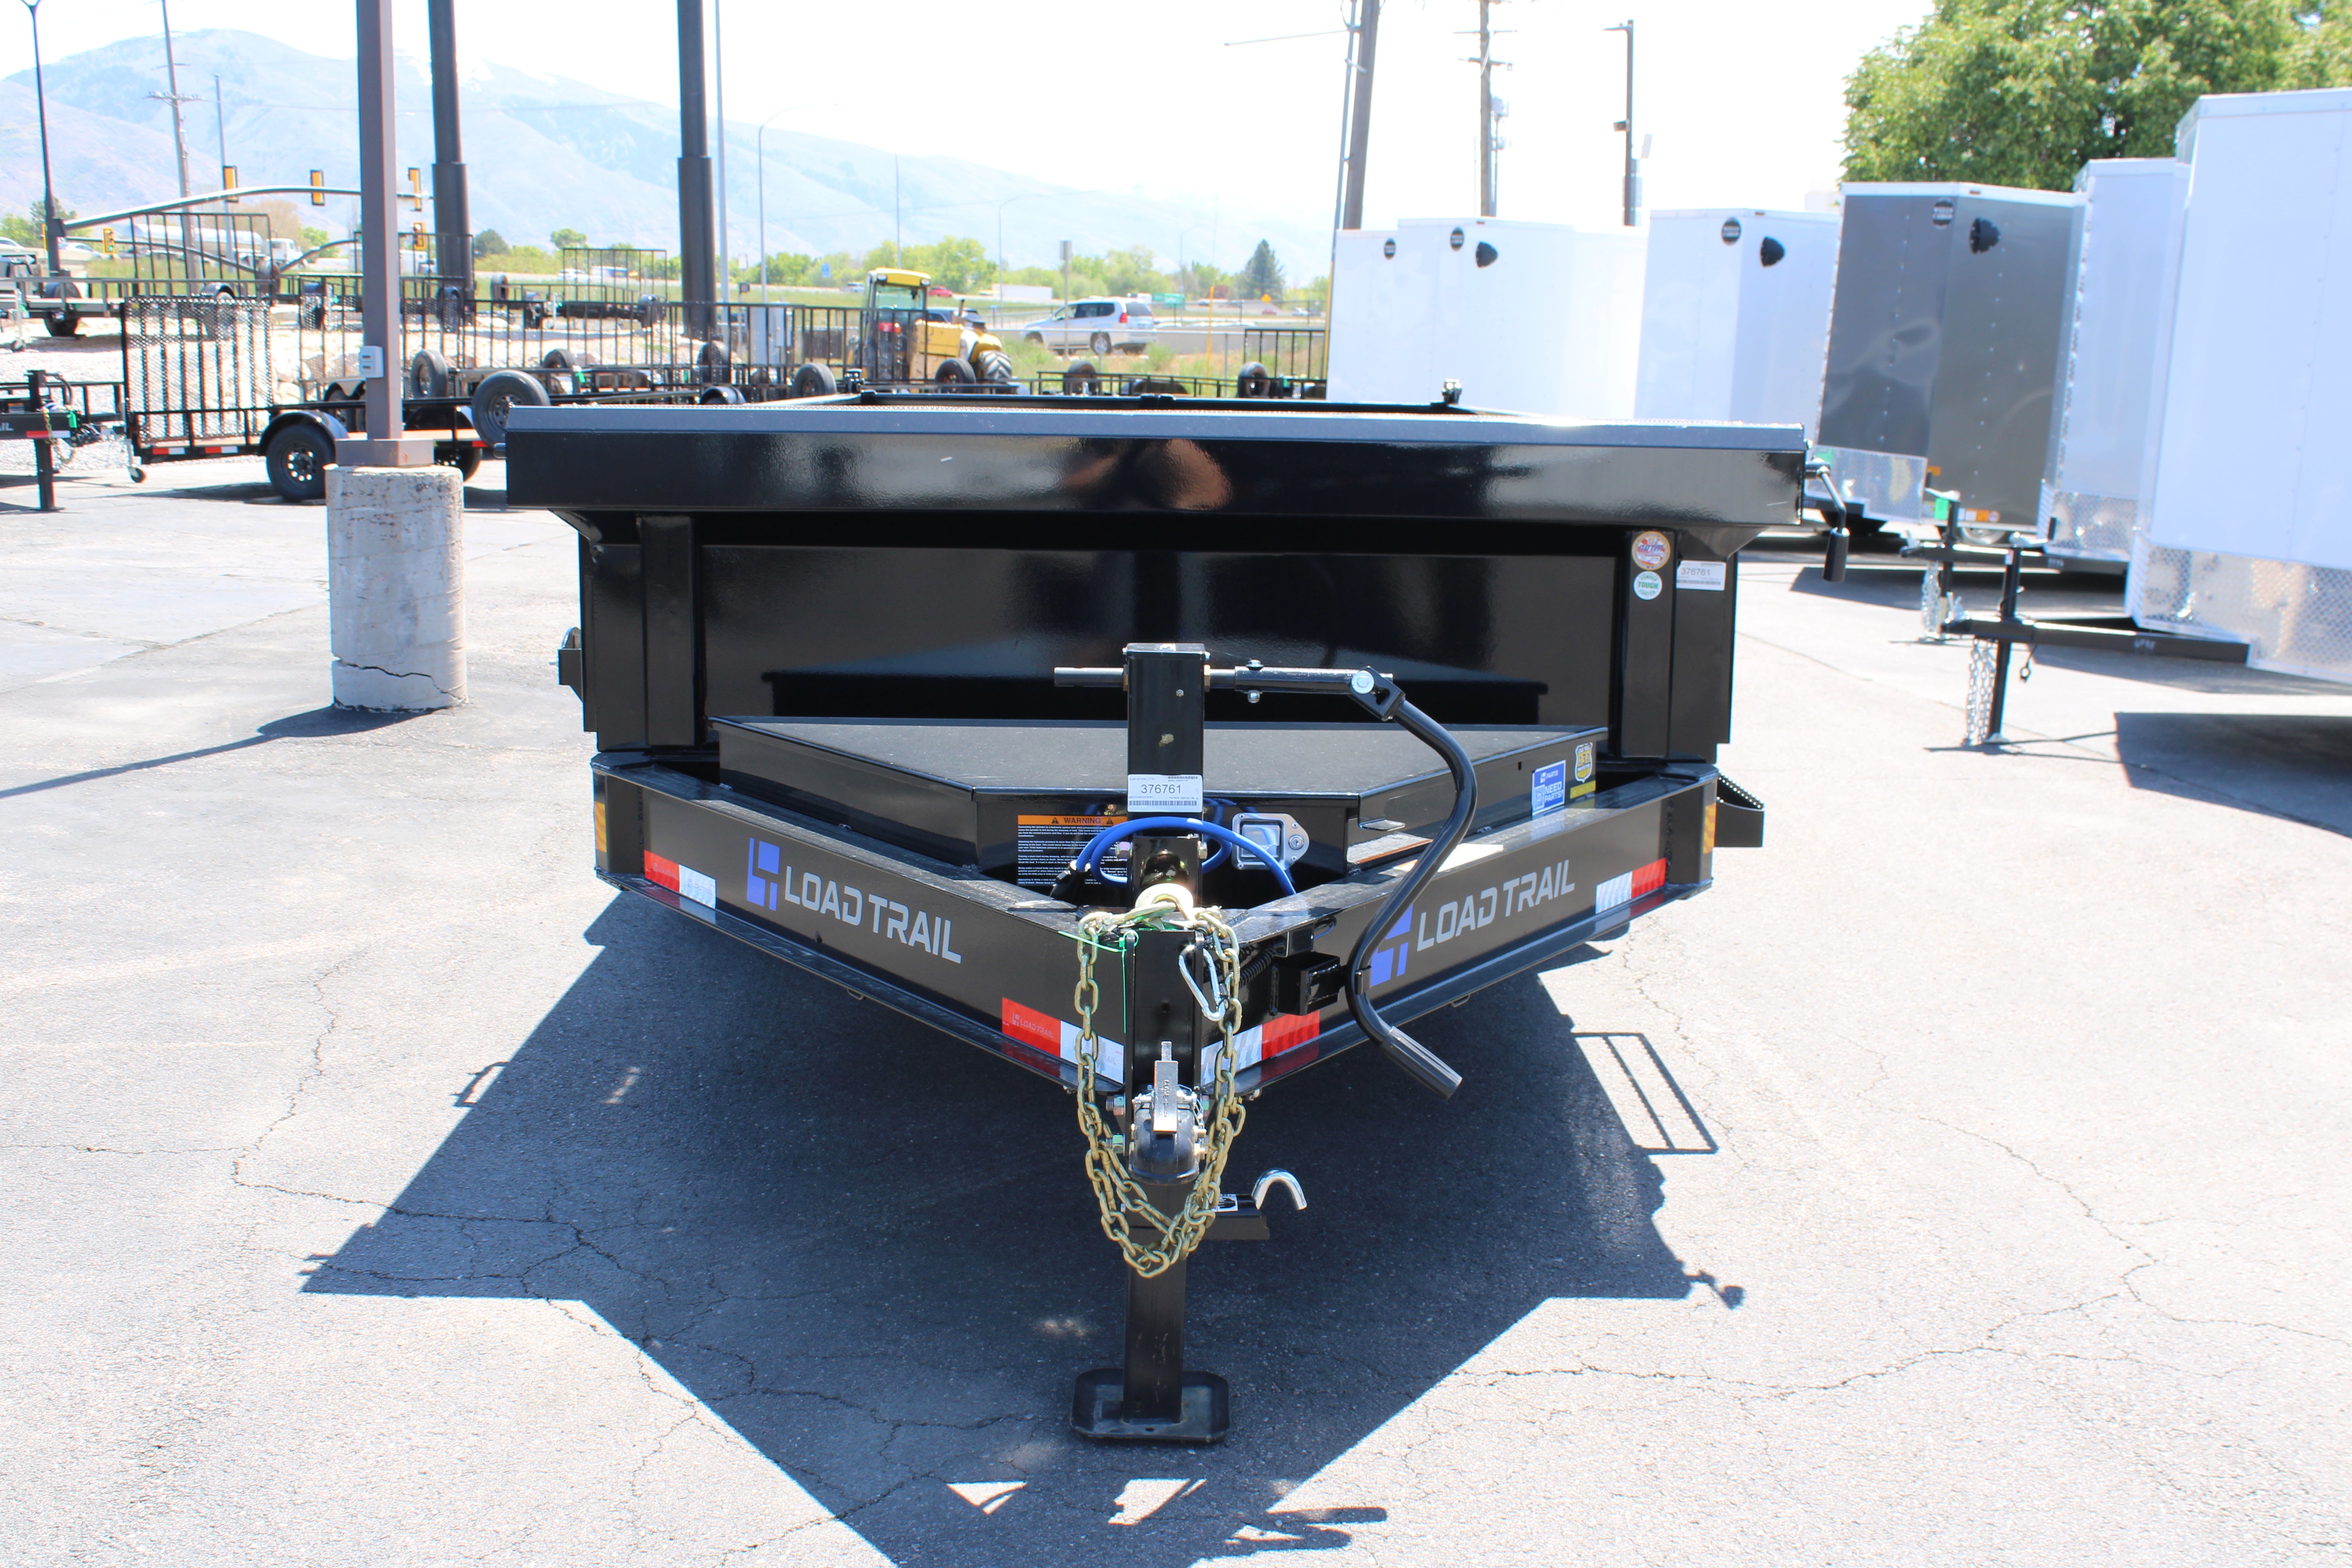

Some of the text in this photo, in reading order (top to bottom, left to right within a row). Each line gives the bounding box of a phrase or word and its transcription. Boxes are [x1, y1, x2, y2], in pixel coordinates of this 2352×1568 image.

[1681, 568, 1711, 576] 376761
[1546, 770, 1558, 779] PARTS
[1141, 784, 1181, 793] 376761
[1545, 781, 1562, 794] NEED
[1545, 790, 1564, 803] PARTS?
[1417, 859, 1575, 952] LOAD TRAIL
[785, 866, 962, 964] LOAD TRAIL
[1020, 1019, 1036, 1030] LOAD
[1036, 1025, 1054, 1038] TRAIL
